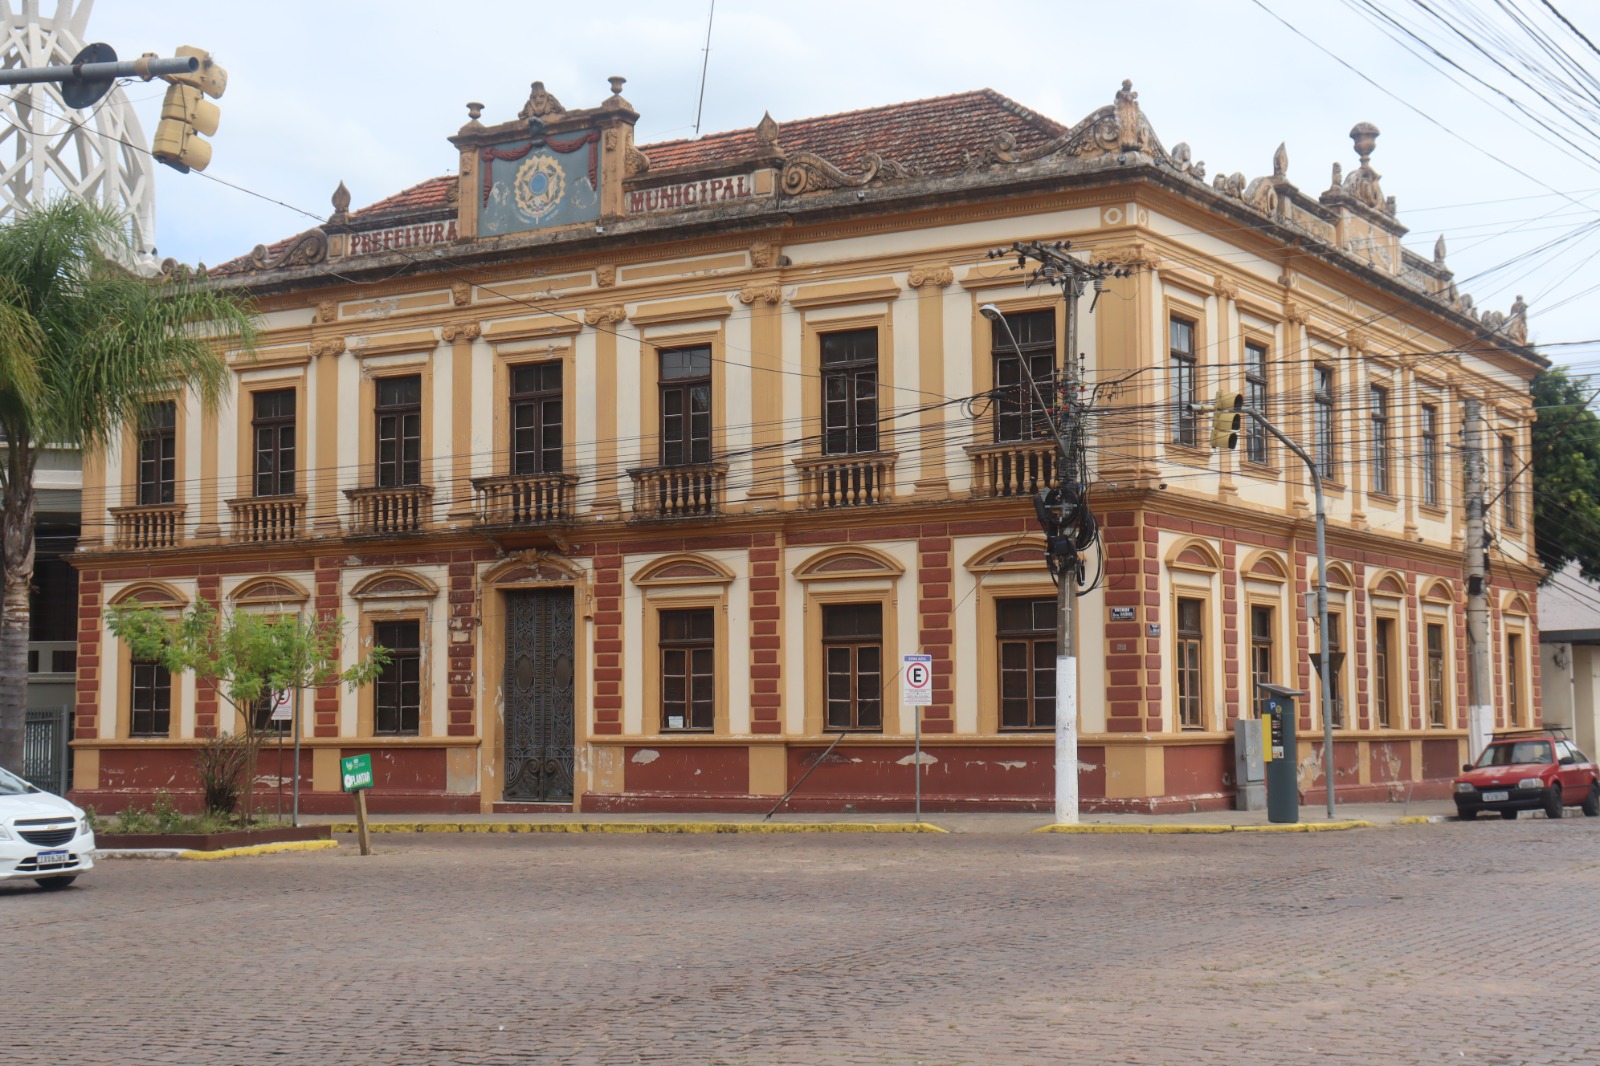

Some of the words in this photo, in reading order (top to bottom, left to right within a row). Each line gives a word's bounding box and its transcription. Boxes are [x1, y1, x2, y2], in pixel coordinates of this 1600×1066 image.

[630, 176, 751, 213] MUNICIPAL
[350, 221, 458, 255] PREFEITURA
[913, 668, 922, 683] E
[1270, 701, 1277, 710] P
